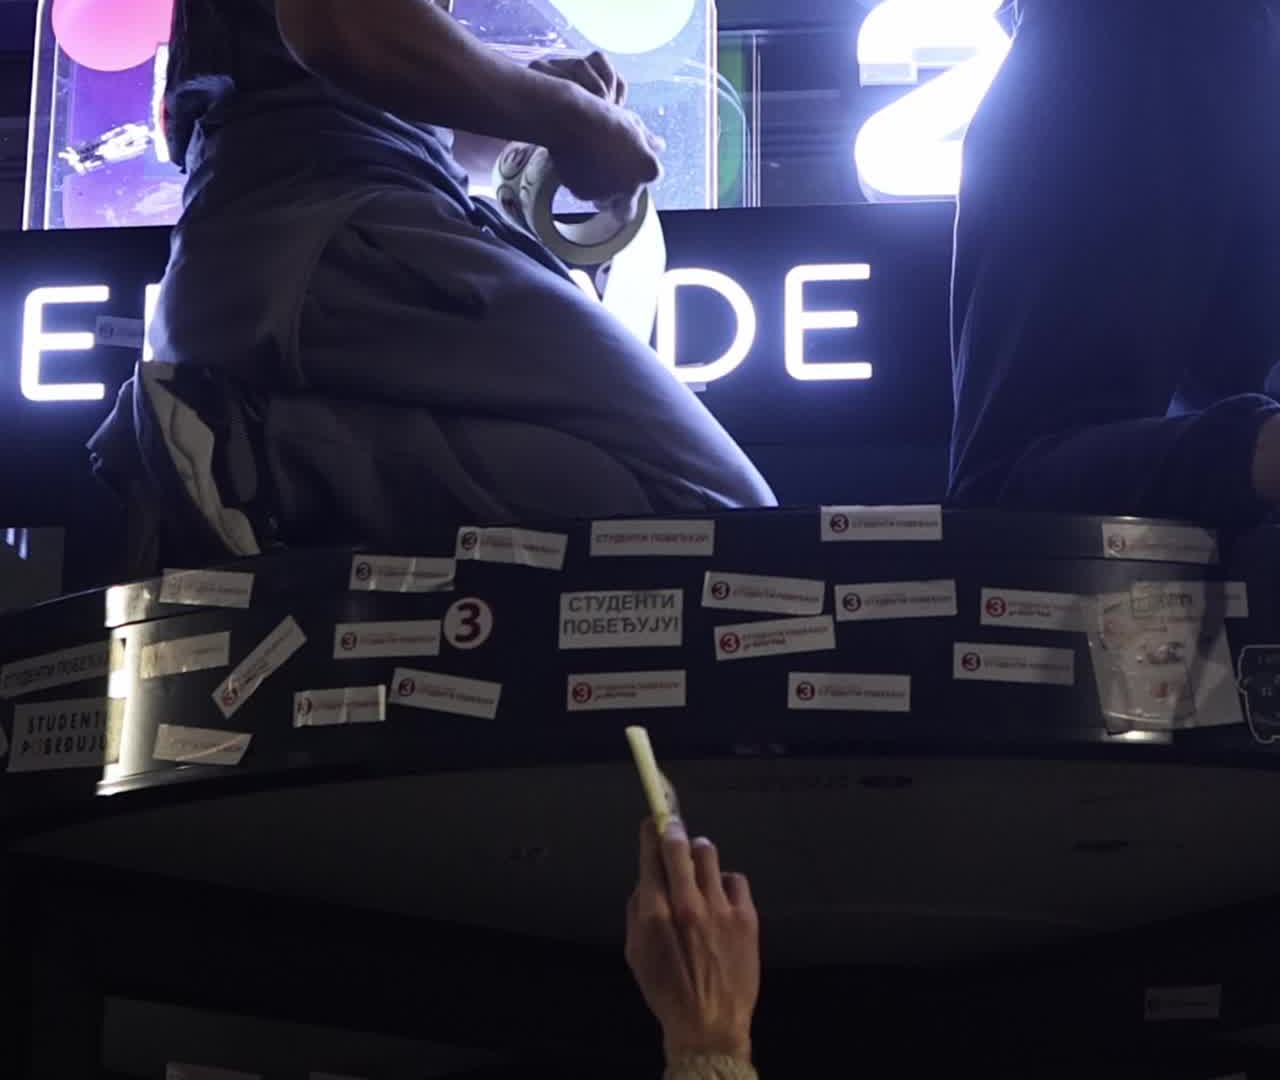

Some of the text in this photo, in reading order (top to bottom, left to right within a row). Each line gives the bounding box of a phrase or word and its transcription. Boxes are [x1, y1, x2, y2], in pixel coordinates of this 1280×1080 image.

[568, 593, 675, 614] СТУДЕНТИ
[454, 602, 482, 643] 3
[563, 615, 680, 636] ПОБЕЂУЈУ!
